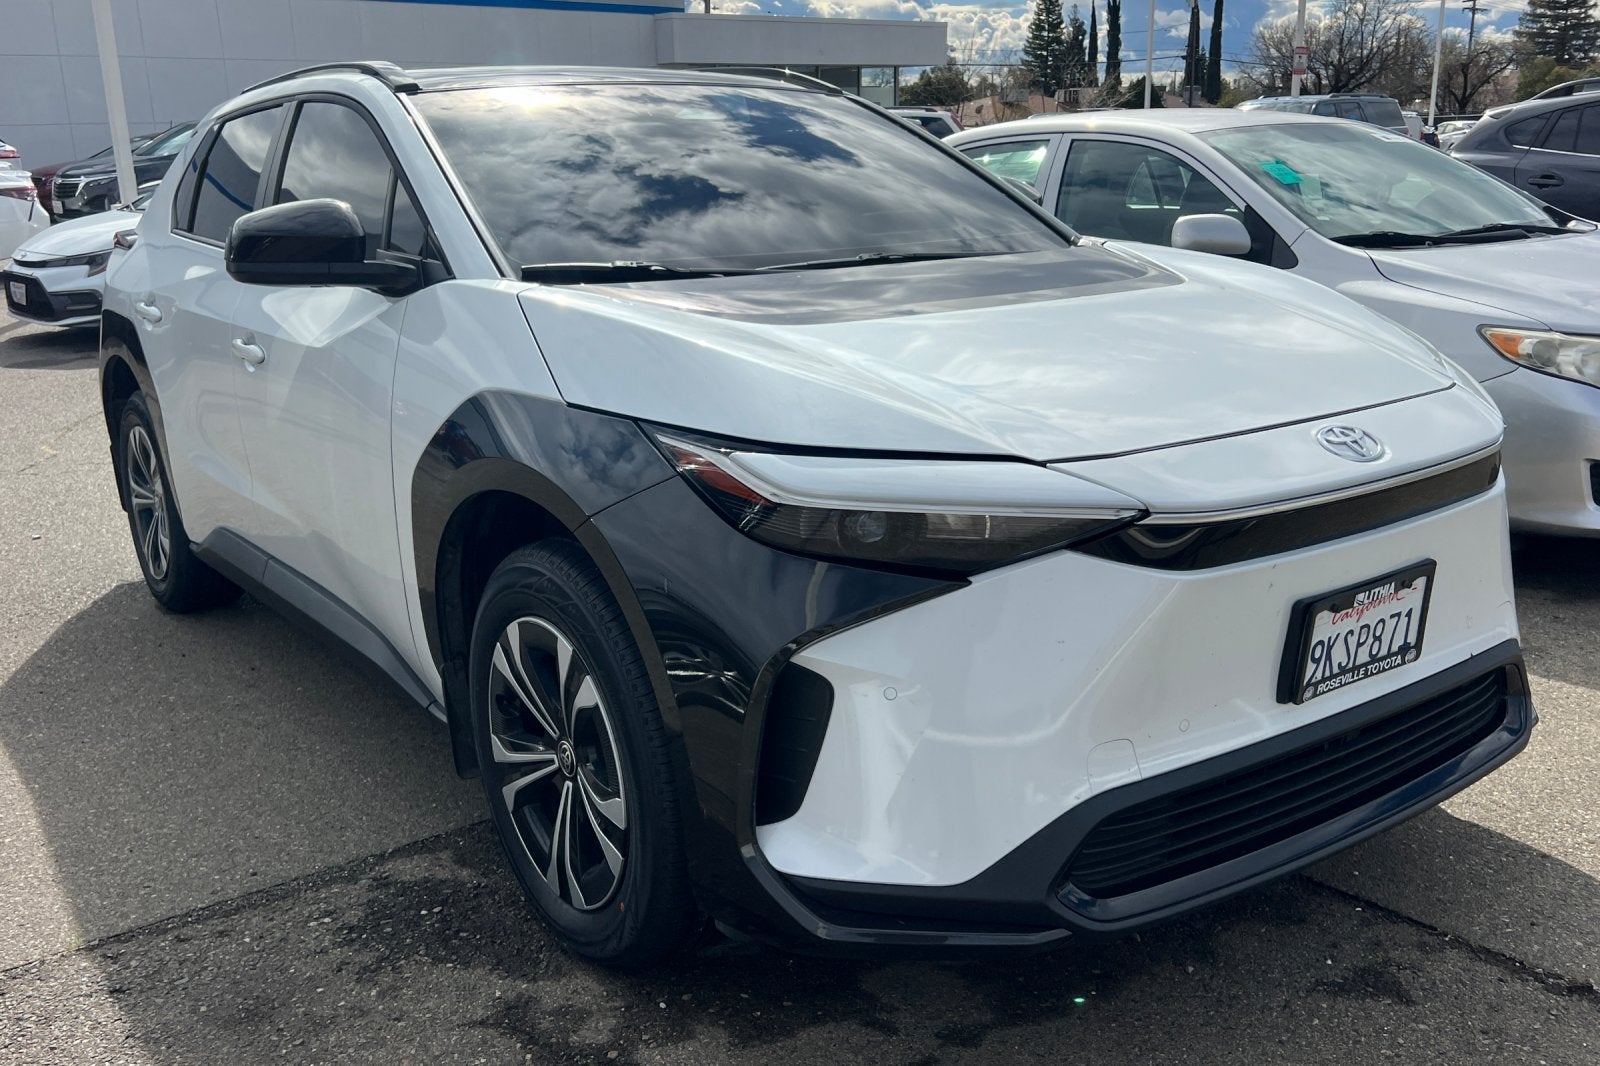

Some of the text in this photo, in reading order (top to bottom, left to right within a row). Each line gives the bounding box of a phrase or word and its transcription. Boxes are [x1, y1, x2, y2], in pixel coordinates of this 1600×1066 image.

[1363, 582, 1395, 603] LITHIA
[1306, 607, 1413, 684] 9KSP871
[1316, 654, 1402, 695] ROSEVILLE TOYOTA
